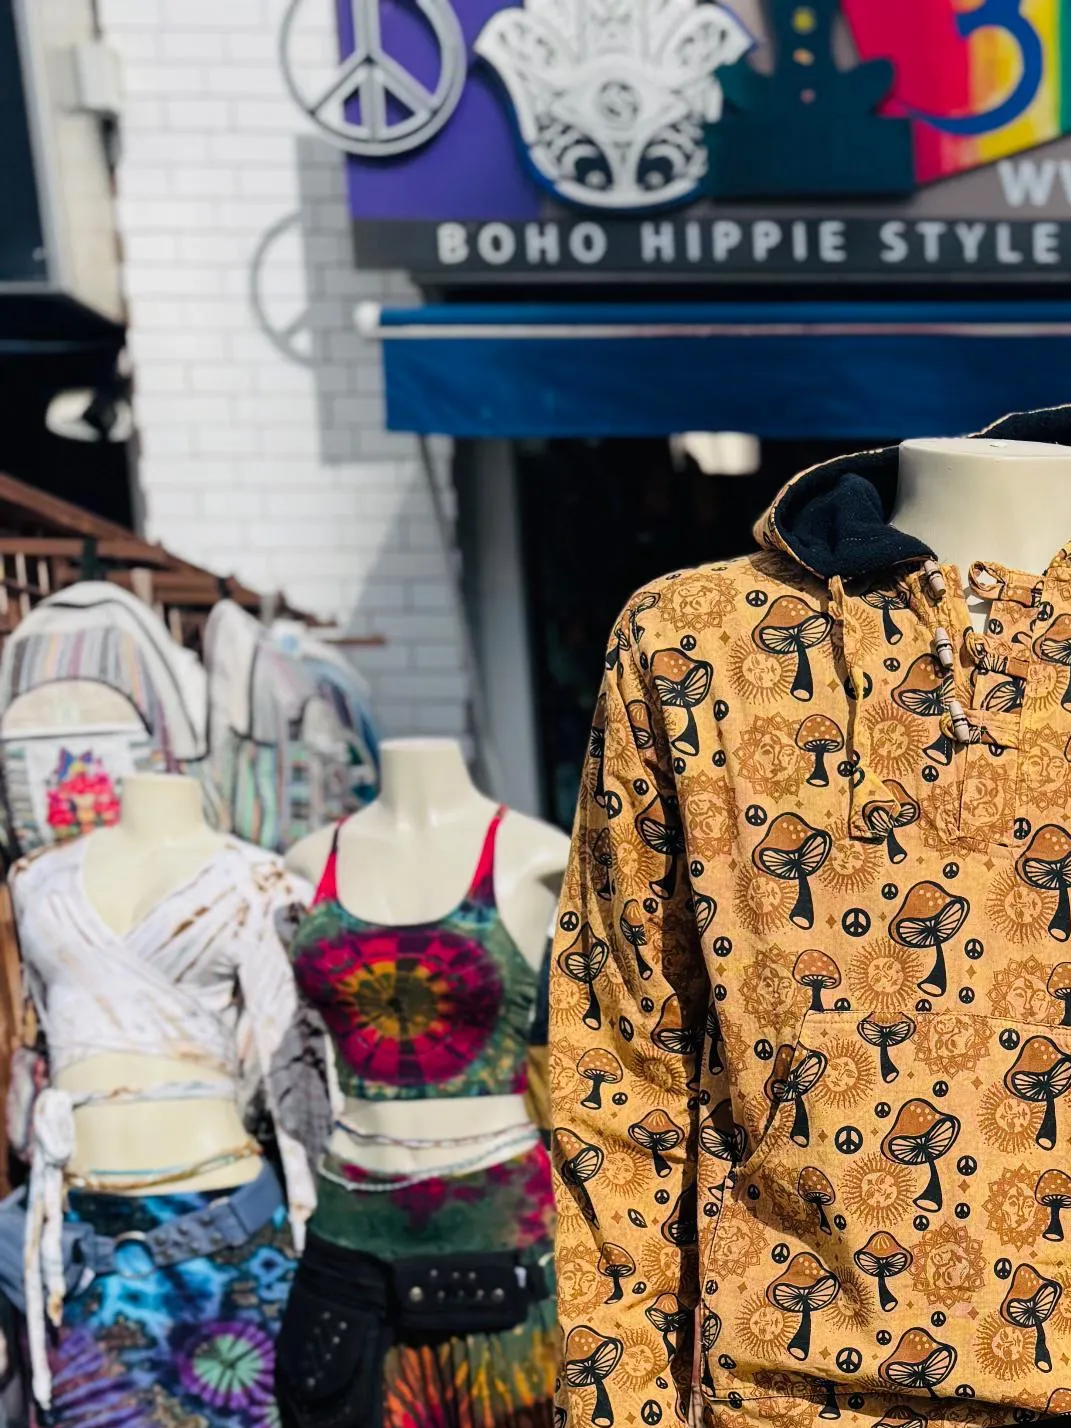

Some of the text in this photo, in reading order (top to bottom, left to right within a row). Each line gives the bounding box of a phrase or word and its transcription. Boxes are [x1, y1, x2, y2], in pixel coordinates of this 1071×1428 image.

[436, 222, 606, 264] BOHO
[641, 221, 846, 262] HIPPIE
[880, 221, 1059, 264] STYLE
